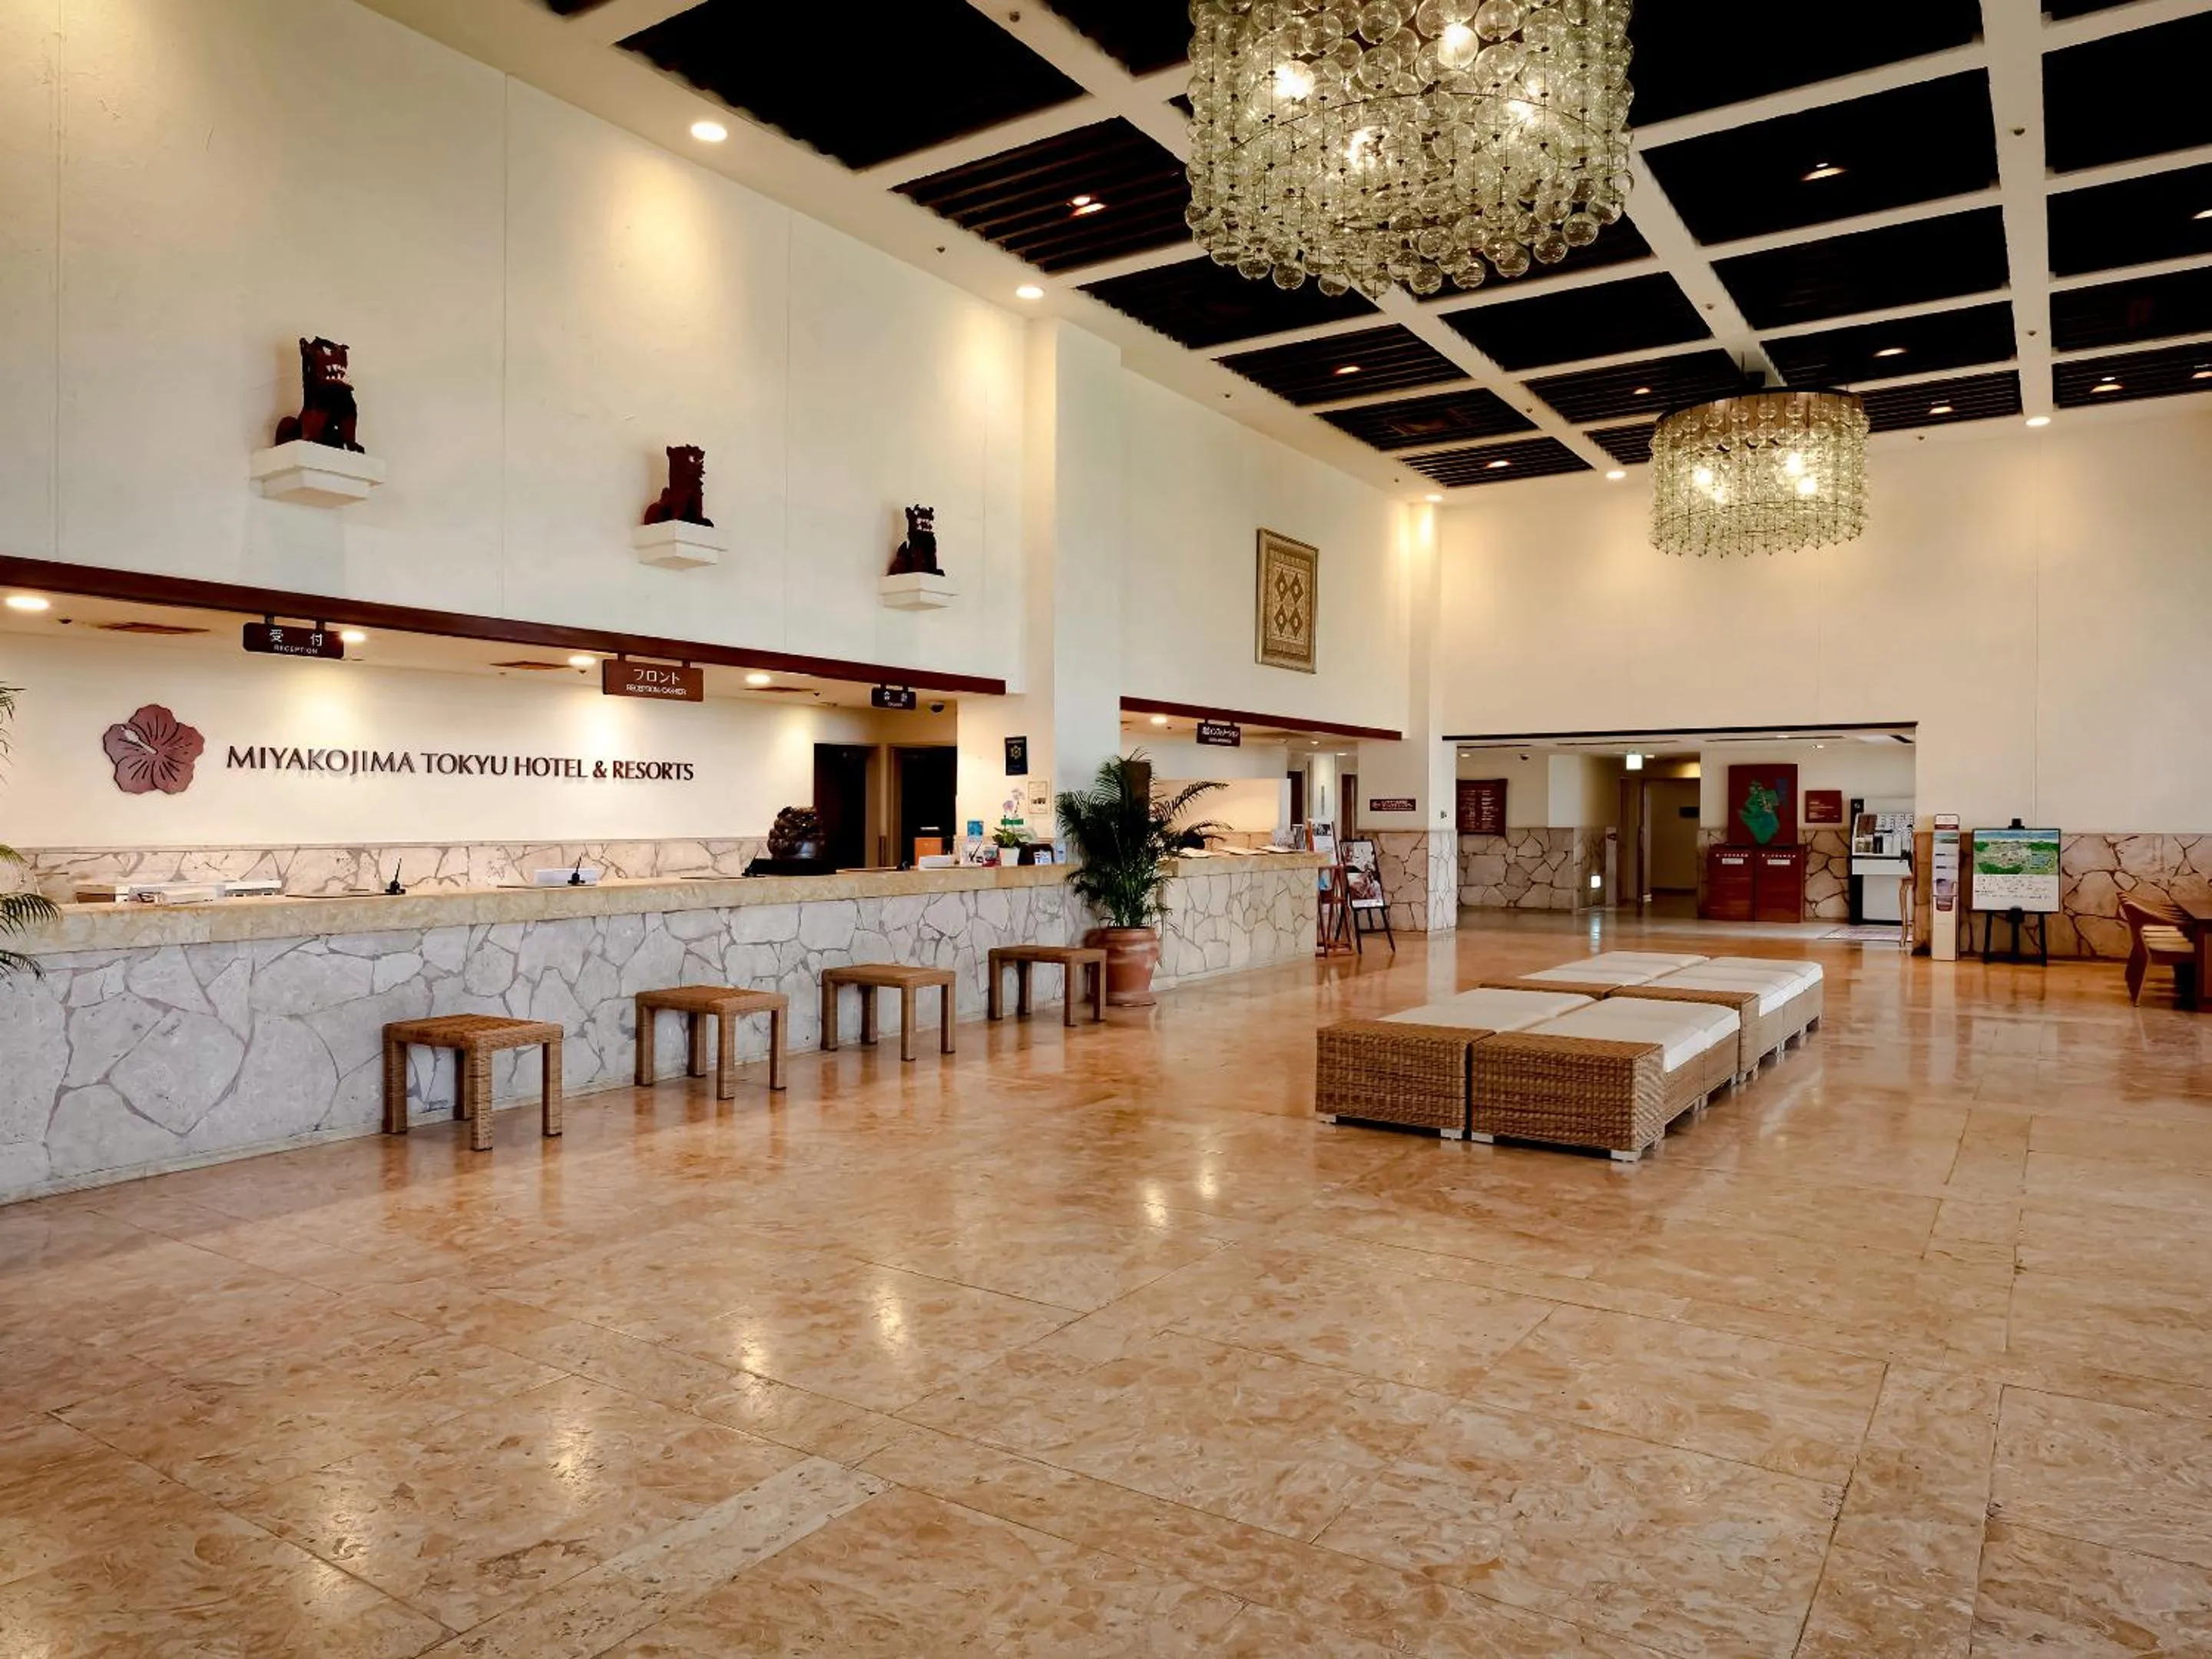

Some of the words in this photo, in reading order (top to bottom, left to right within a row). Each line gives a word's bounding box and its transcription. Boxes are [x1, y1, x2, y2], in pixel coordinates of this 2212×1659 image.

[634, 668, 680, 685] フロント
[227, 746, 416, 776] MIYAKOJIMA
[420, 752, 508, 776] TOKYU
[514, 757, 588, 778] HOTEL
[592, 760, 607, 778] &
[612, 760, 694, 780] RESORTS
